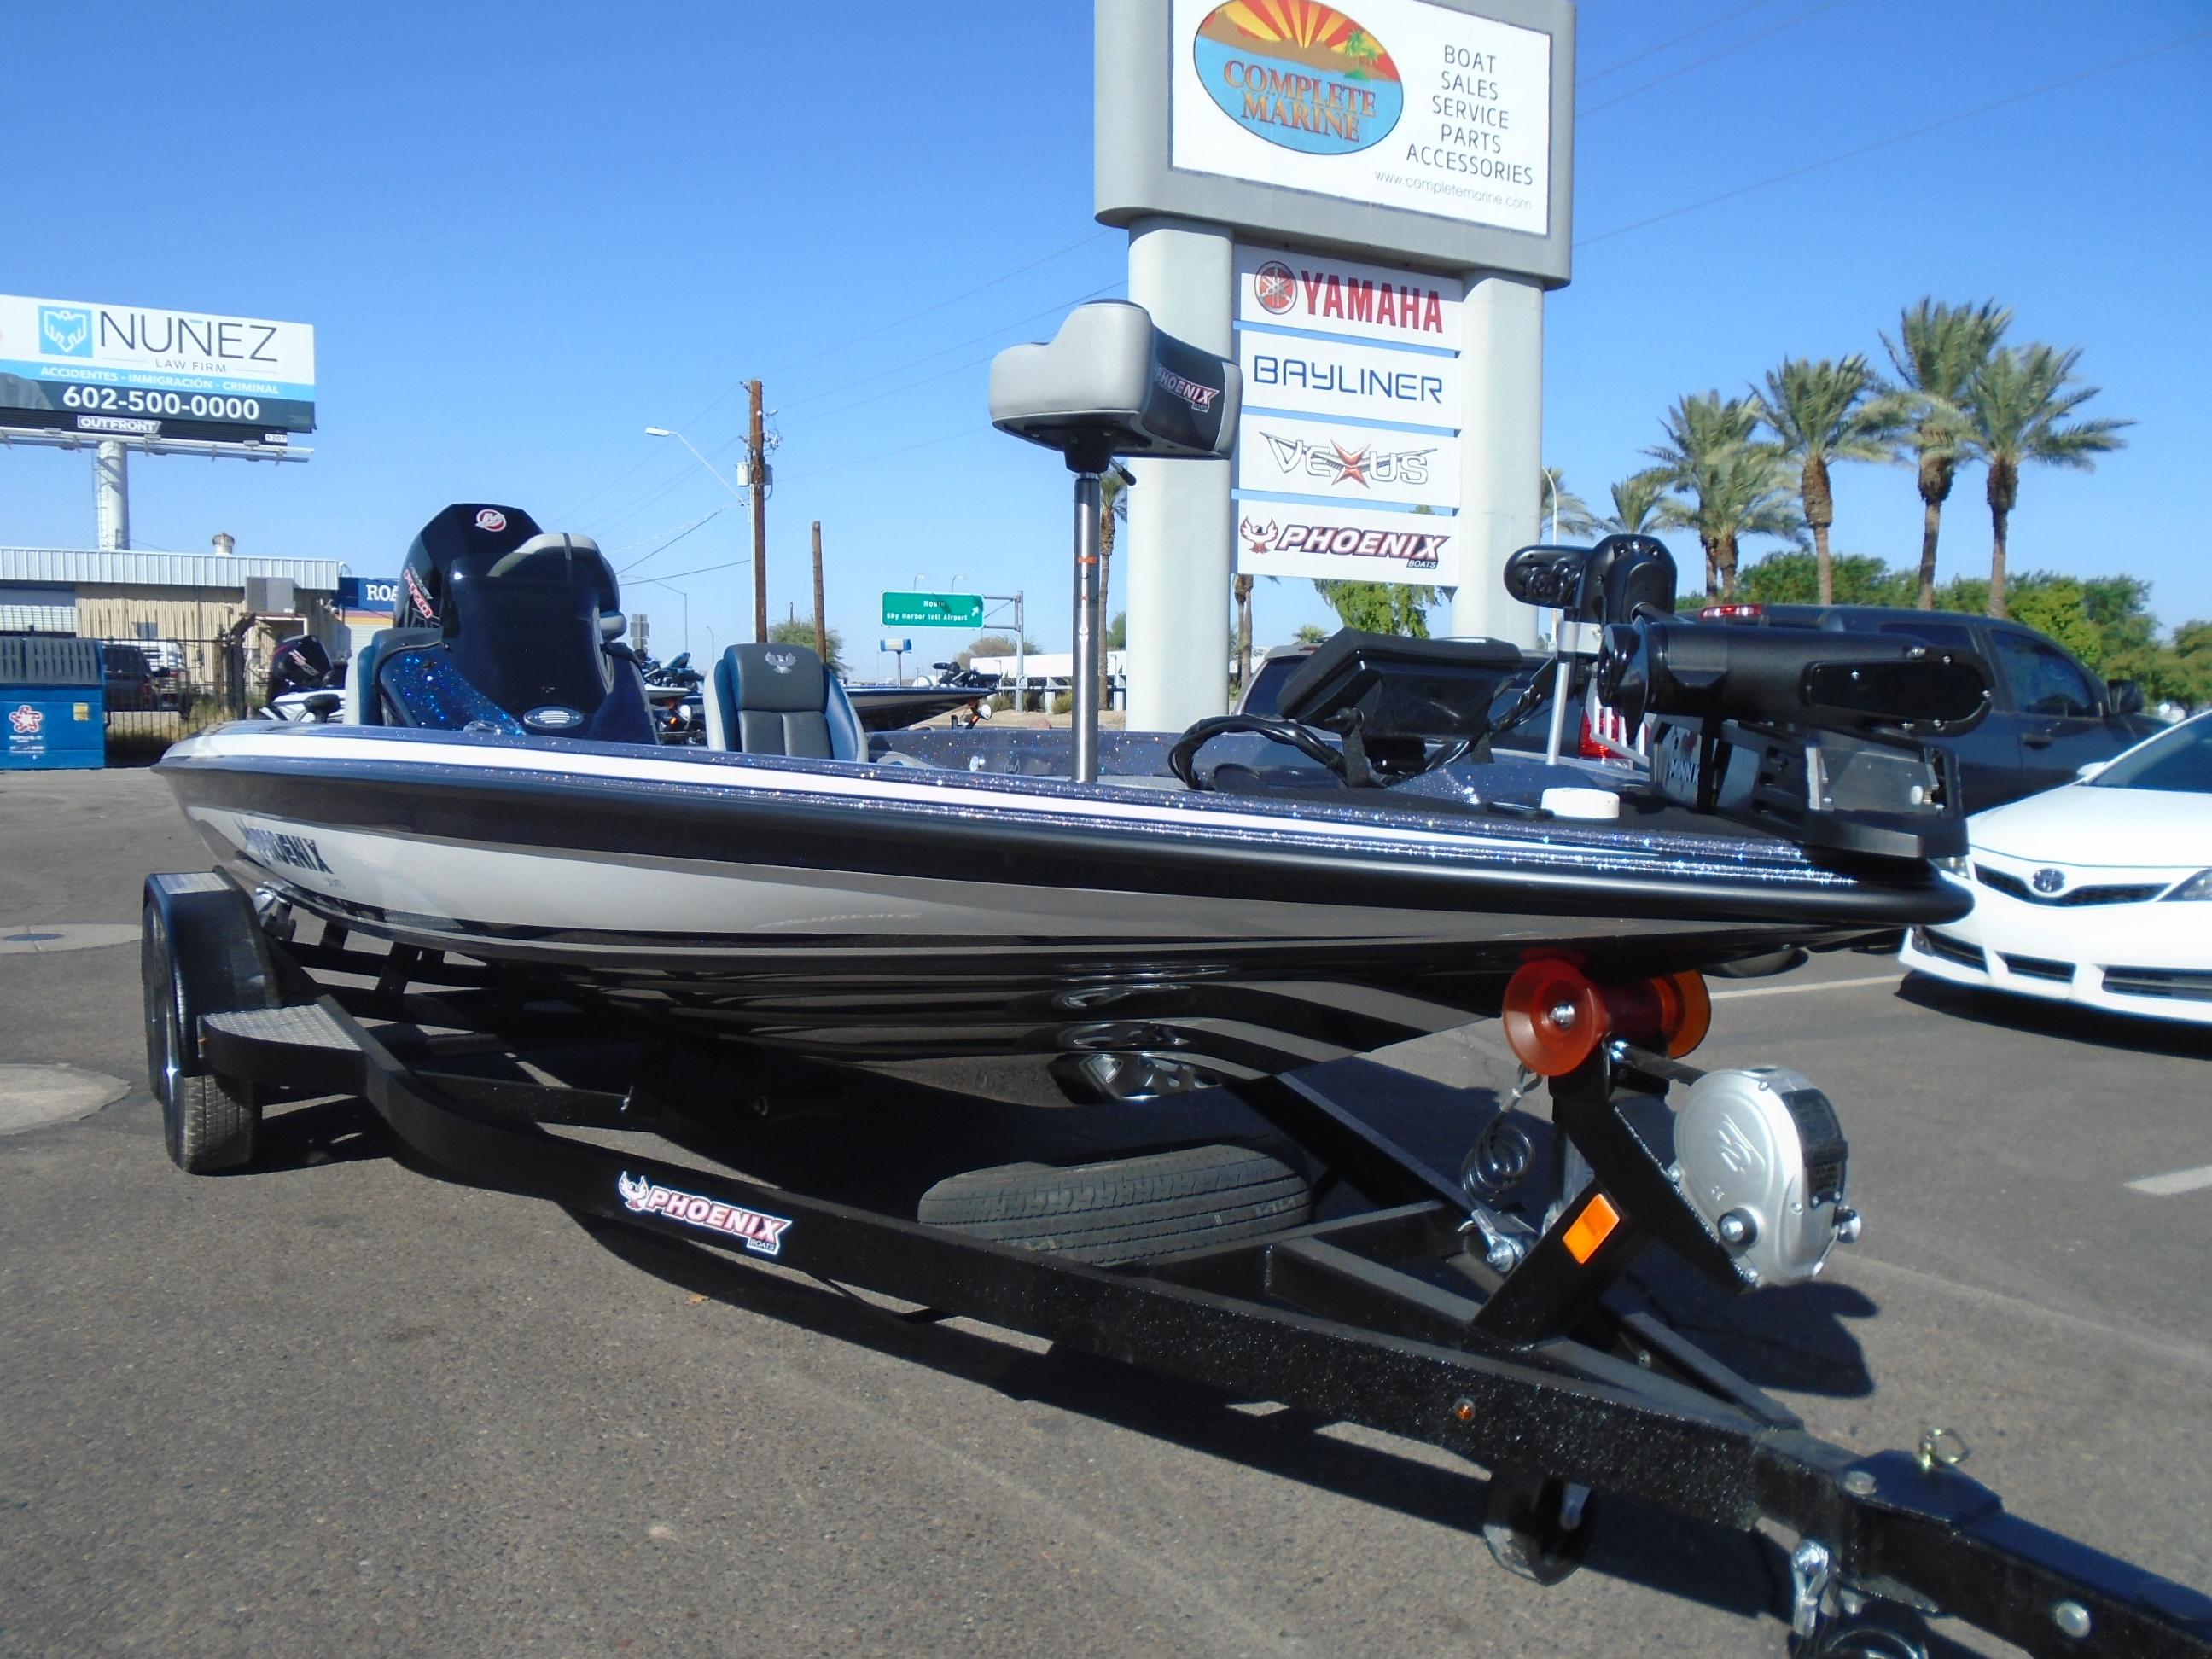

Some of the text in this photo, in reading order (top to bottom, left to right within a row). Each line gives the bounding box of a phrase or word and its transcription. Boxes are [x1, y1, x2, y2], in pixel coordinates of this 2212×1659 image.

[1445, 45, 1496, 74] BOAT
[1224, 59, 1377, 118] COMPLETE
[1441, 71, 1499, 101] SALES
[1241, 92, 1361, 143] MARINE
[1432, 96, 1510, 130] SERVICE
[1441, 125, 1501, 154] PARTS
[1406, 143, 1534, 186] ACCESSORIES
[1375, 171, 1533, 210] www.completemarine.com
[1301, 270, 1443, 334] YAMAHA
[40, 367, 279, 394] ACCIDENTES INMIGRACIÓN CRIMINAL
[155, 358, 227, 373] LAW FIRM
[1254, 355, 1442, 404] BAYLINER
[63, 386, 259, 420] 602-500-0000
[80, 416, 156, 432] OUTFRONT
[1260, 433, 1437, 489] VEXUS
[1276, 524, 1451, 562] PHOENIX
[1408, 559, 1437, 569] BOATS
[887, 613, 899, 621] Sky
[647, 1186, 788, 1243] PHOENIX
[750, 1238, 776, 1251] BOATS
